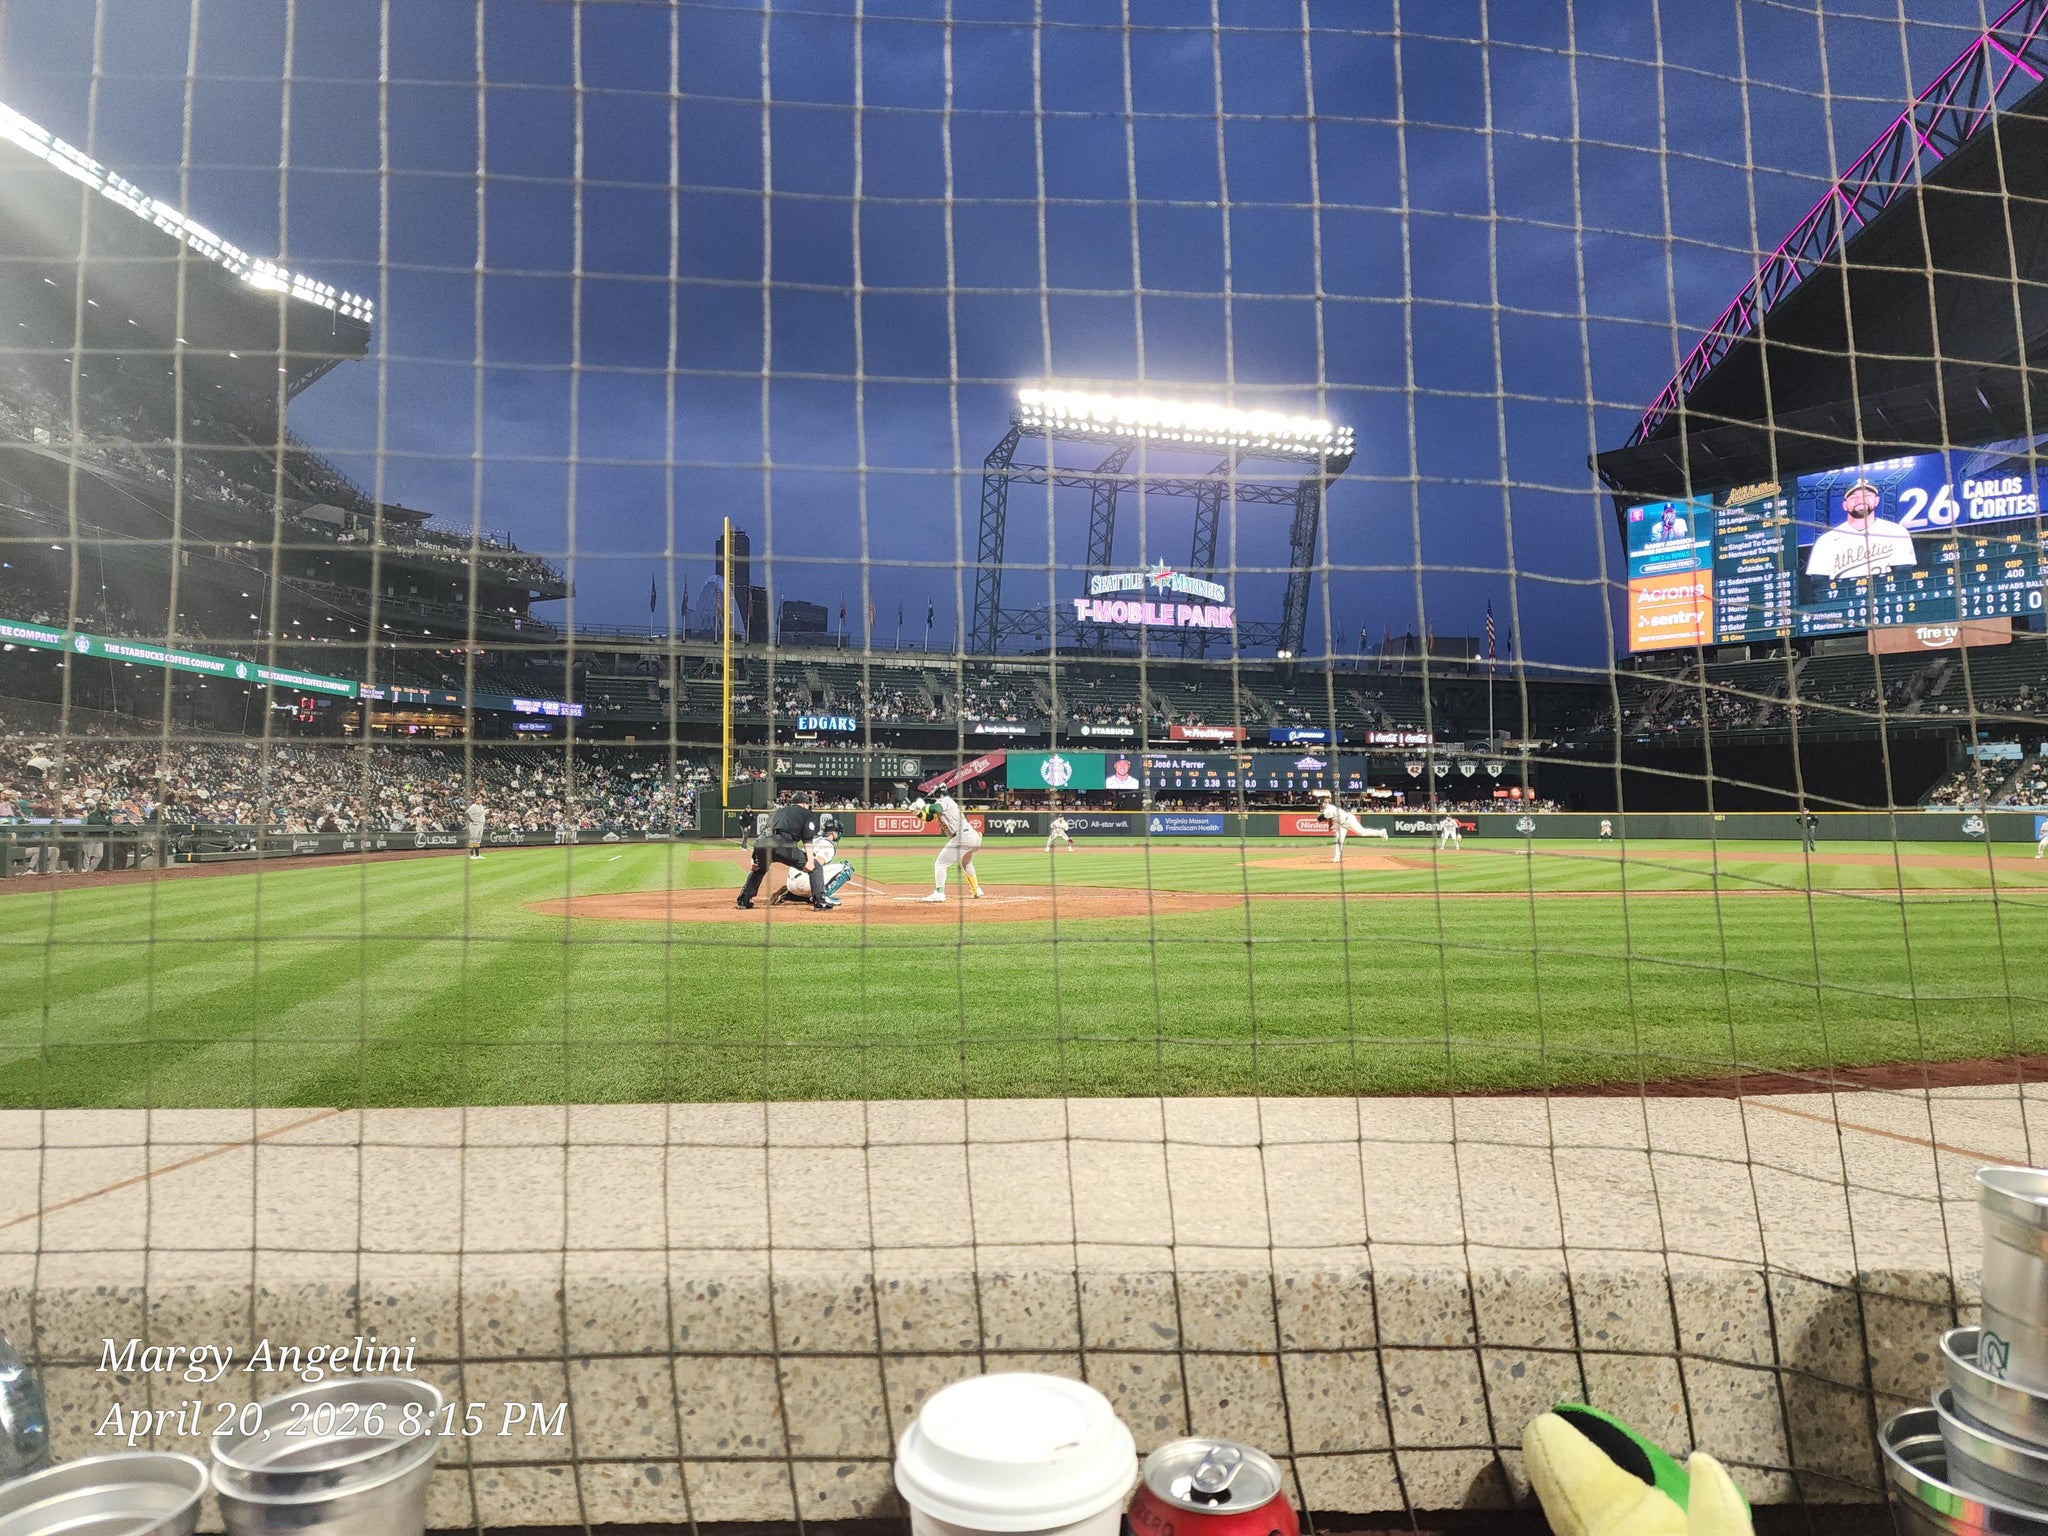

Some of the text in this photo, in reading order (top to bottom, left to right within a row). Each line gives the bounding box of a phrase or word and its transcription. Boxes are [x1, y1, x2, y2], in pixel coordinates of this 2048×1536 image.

[1963, 477, 2023, 499] CARLOS
[1900, 484, 1960, 528] 26
[1969, 494, 2038, 520] CORTES
[1727, 526, 1747, 534] Cortes
[1745, 532, 1765, 540] Tonight
[2006, 534, 2021, 542] RBI
[414, 539, 441, 551] Trident
[1728, 542, 1752, 551] Singled
[1728, 548, 1757, 558] Homered
[1767, 545, 1784, 554] Right
[1833, 543, 1894, 573] Athletics
[1941, 545, 2018, 562] .308 2 7
[1856, 578, 1868, 586] AB
[1912, 571, 1929, 579] XBH
[1975, 564, 1988, 572] BB
[2005, 560, 2023, 569] OBP
[1091, 572, 1226, 603] SEATTLE MARINERS
[1727, 576, 1763, 586] Soderstrom
[1827, 569, 2025, 599] 17 39 12 5 5 6 .400
[1637, 584, 1705, 604] Acronis
[1763, 592, 1774, 600] 2B
[1813, 612, 1842, 621] Athletics
[1848, 609, 1855, 617] 0
[1860, 608, 1867, 616] 0
[1873, 607, 1879, 615] 0
[1896, 604, 1903, 612] 0
[1909, 602, 1915, 611] 2
[1961, 597, 1967, 606] 3
[1973, 596, 1980, 605] 7
[1987, 594, 1993, 603] 0
[2000, 593, 2007, 602] 3
[2014, 592, 2021, 600] 2
[2029, 591, 2042, 609] 0
[1074, 598, 1235, 628] T-MOBILE PARK
[1650, 611, 1705, 627] sentry
[1813, 602, 2021, 631] Mariners 0 0 3 6 0 4 2
[1728, 623, 1745, 631] Gelof
[1916, 626, 1959, 640] fire tv
[13, 628, 61, 644] COMPANY
[104, 643, 225, 672] THE STARBUCKS COFFEE COMPANY
[257, 670, 351, 692] THE STARBUCKS COFFEE COMPANY
[1092, 727, 1134, 735] STARBUCKS
[1143, 760, 1152, 768] 45
[1154, 760, 1171, 768] José
[1172, 760, 1180, 768] A.
[1181, 760, 1206, 768] Ferrer
[1160, 778, 1166, 787] 0
[1176, 779, 1181, 787] 0
[1191, 779, 1196, 787] 2
[1204, 779, 1220, 787] 3.38
[1227, 779, 1236, 787] 12
[1245, 780, 1257, 788] 8.0
[1270, 780, 1279, 788] 13
[1302, 780, 1308, 788] 0
[1348, 781, 1363, 789] .361
[878, 818, 924, 829] BECU
[988, 819, 1030, 829] TOYTA
[1067, 819, 1129, 830] ero All-star wifi.
[1165, 818, 1188, 826] Virginia
[1300, 820, 1329, 830] Ninten
[1520, 820, 1531, 828] 50
[1967, 819, 1984, 828] 50
[426, 835, 457, 844] LEXUS
[489, 831, 525, 845] Great Clips
[554, 831, 579, 844] STIHL
